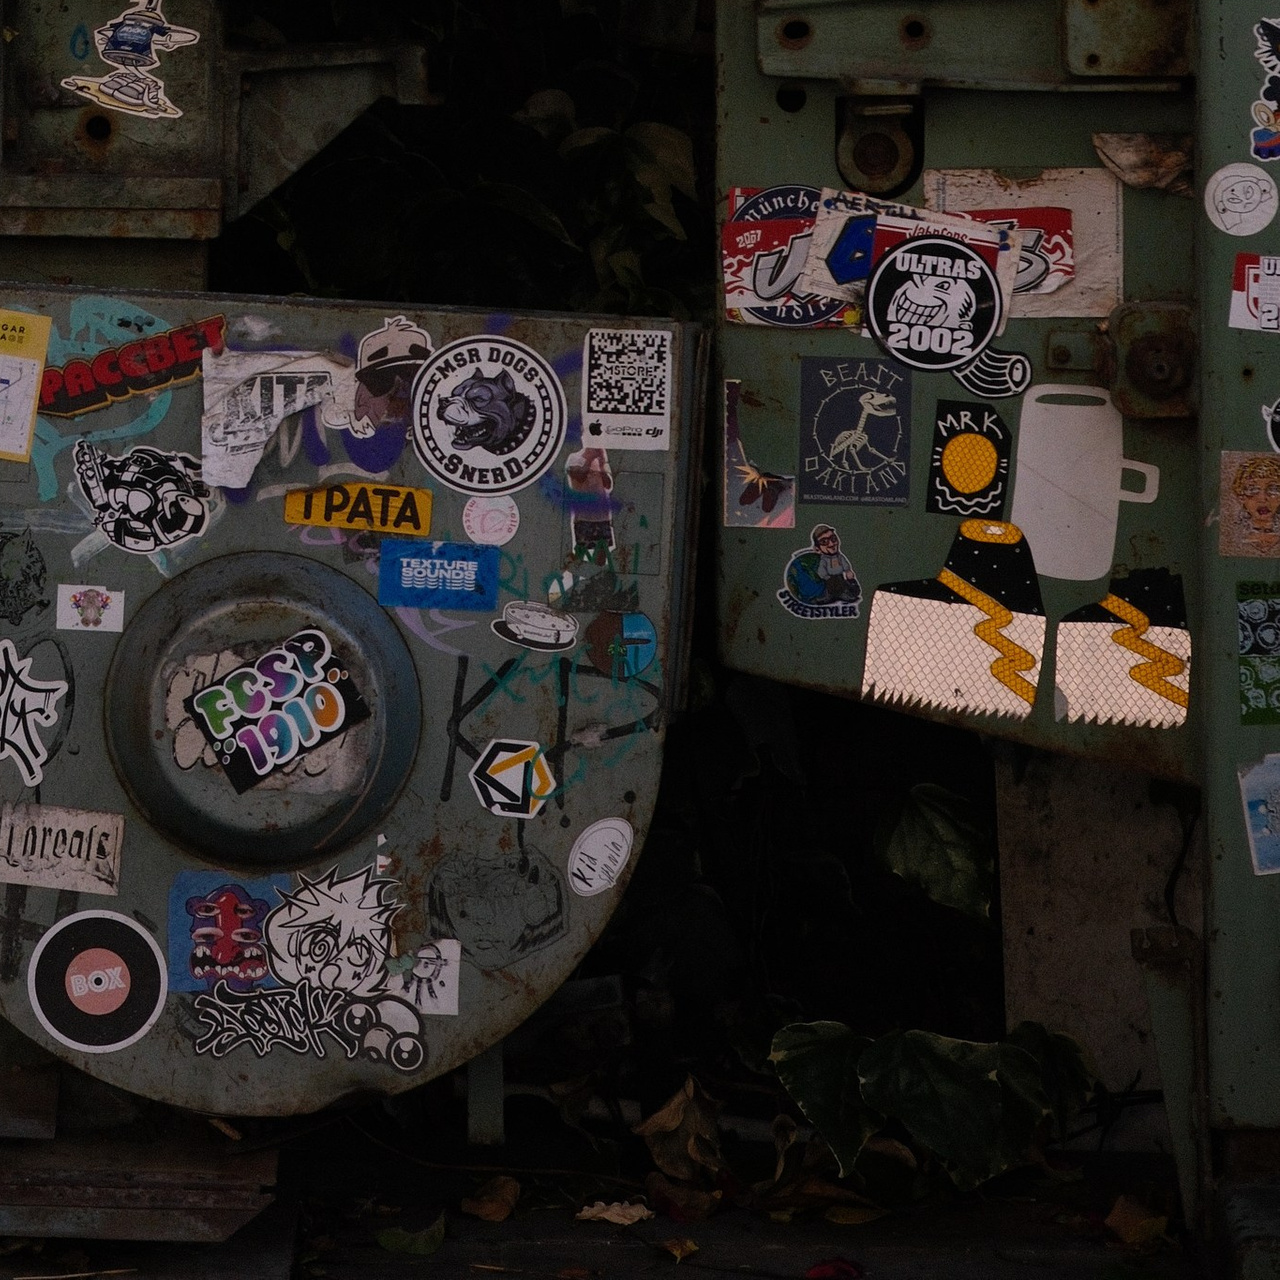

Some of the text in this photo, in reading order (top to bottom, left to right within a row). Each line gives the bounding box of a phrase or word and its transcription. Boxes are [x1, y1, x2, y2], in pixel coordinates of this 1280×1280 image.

[896, 252, 982, 279] ULTRAS
[1, 324, 25, 334] GAR
[888, 324, 974, 355] 2002
[436, 347, 539, 383] MSR DOGS
[604, 366, 653, 376] MSTORE
[820, 362, 903, 389] BEAST
[606, 425, 643, 435] GoPro
[805, 456, 906, 494] OAKLAND
[400, 558, 478, 571] TEXTURE
[401, 568, 476, 583] SOUNDS
[778, 589, 858, 619] STREETSTYLER
[237, 681, 346, 776] 1910
[71, 966, 125, 996] BOX
